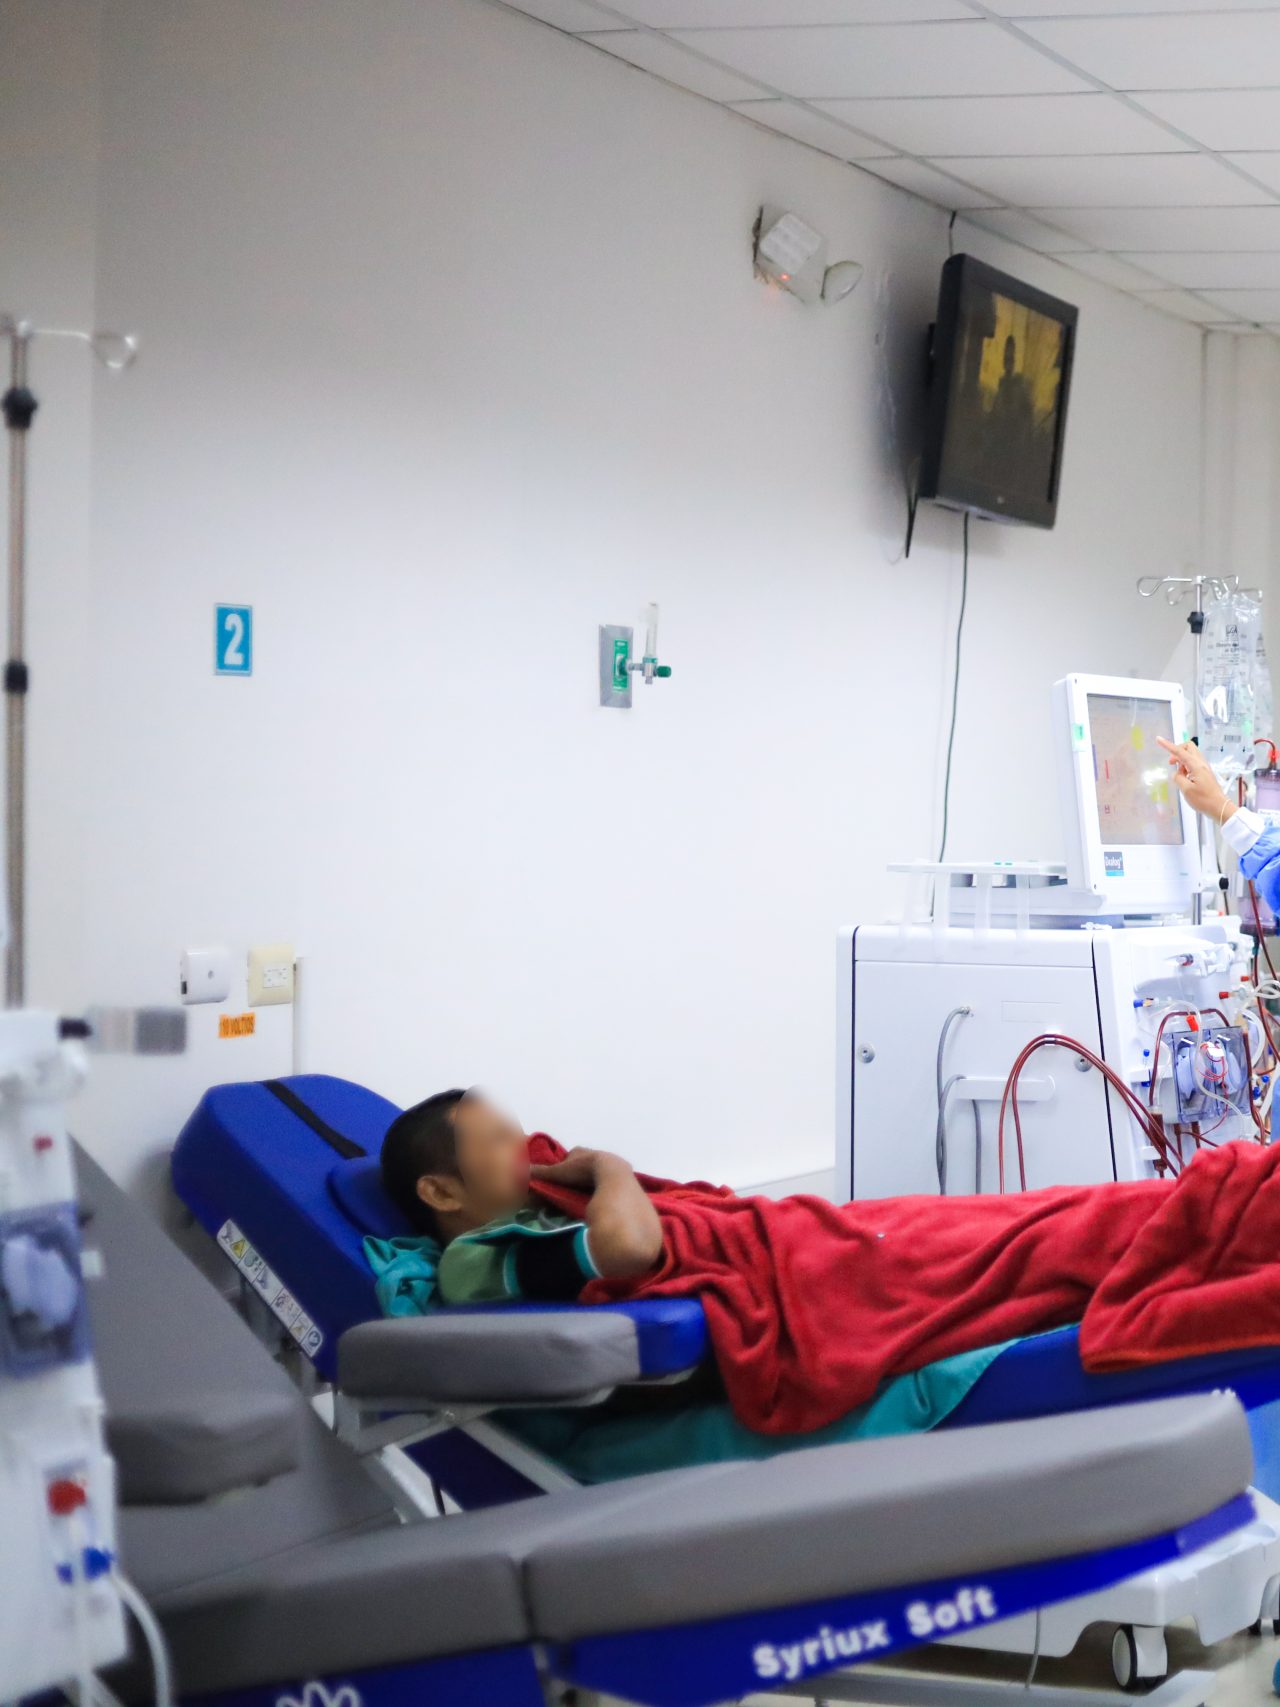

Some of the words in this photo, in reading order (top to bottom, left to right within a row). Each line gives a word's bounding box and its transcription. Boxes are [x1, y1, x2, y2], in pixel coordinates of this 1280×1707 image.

[224, 613, 244, 665] 2
[753, 1620, 890, 1680] Syriux
[906, 1587, 998, 1637] Soft
